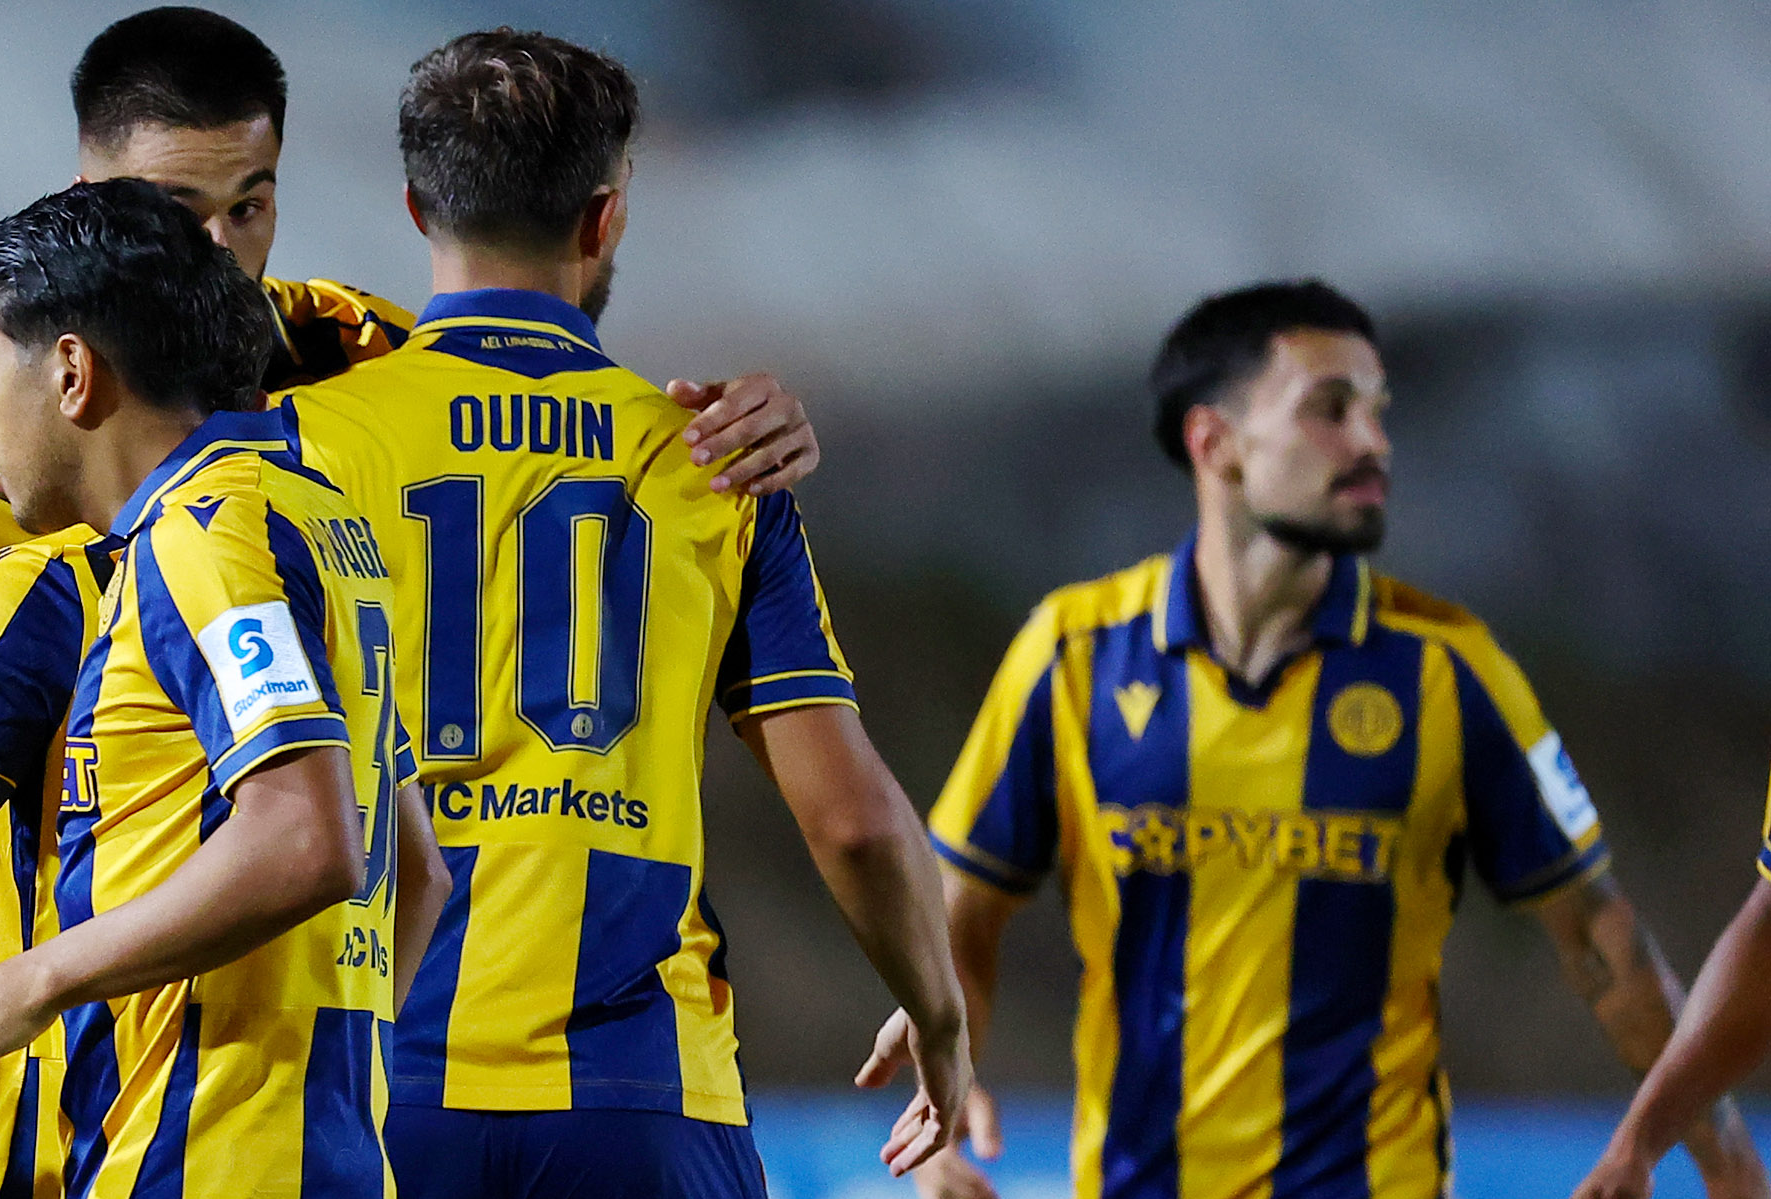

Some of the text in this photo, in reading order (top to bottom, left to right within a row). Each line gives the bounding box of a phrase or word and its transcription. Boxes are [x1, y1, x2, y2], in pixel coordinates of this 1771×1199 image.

[449, 394, 614, 461] OUDIN
[401, 474, 652, 761] 10
[480, 778, 649, 830] Markets
